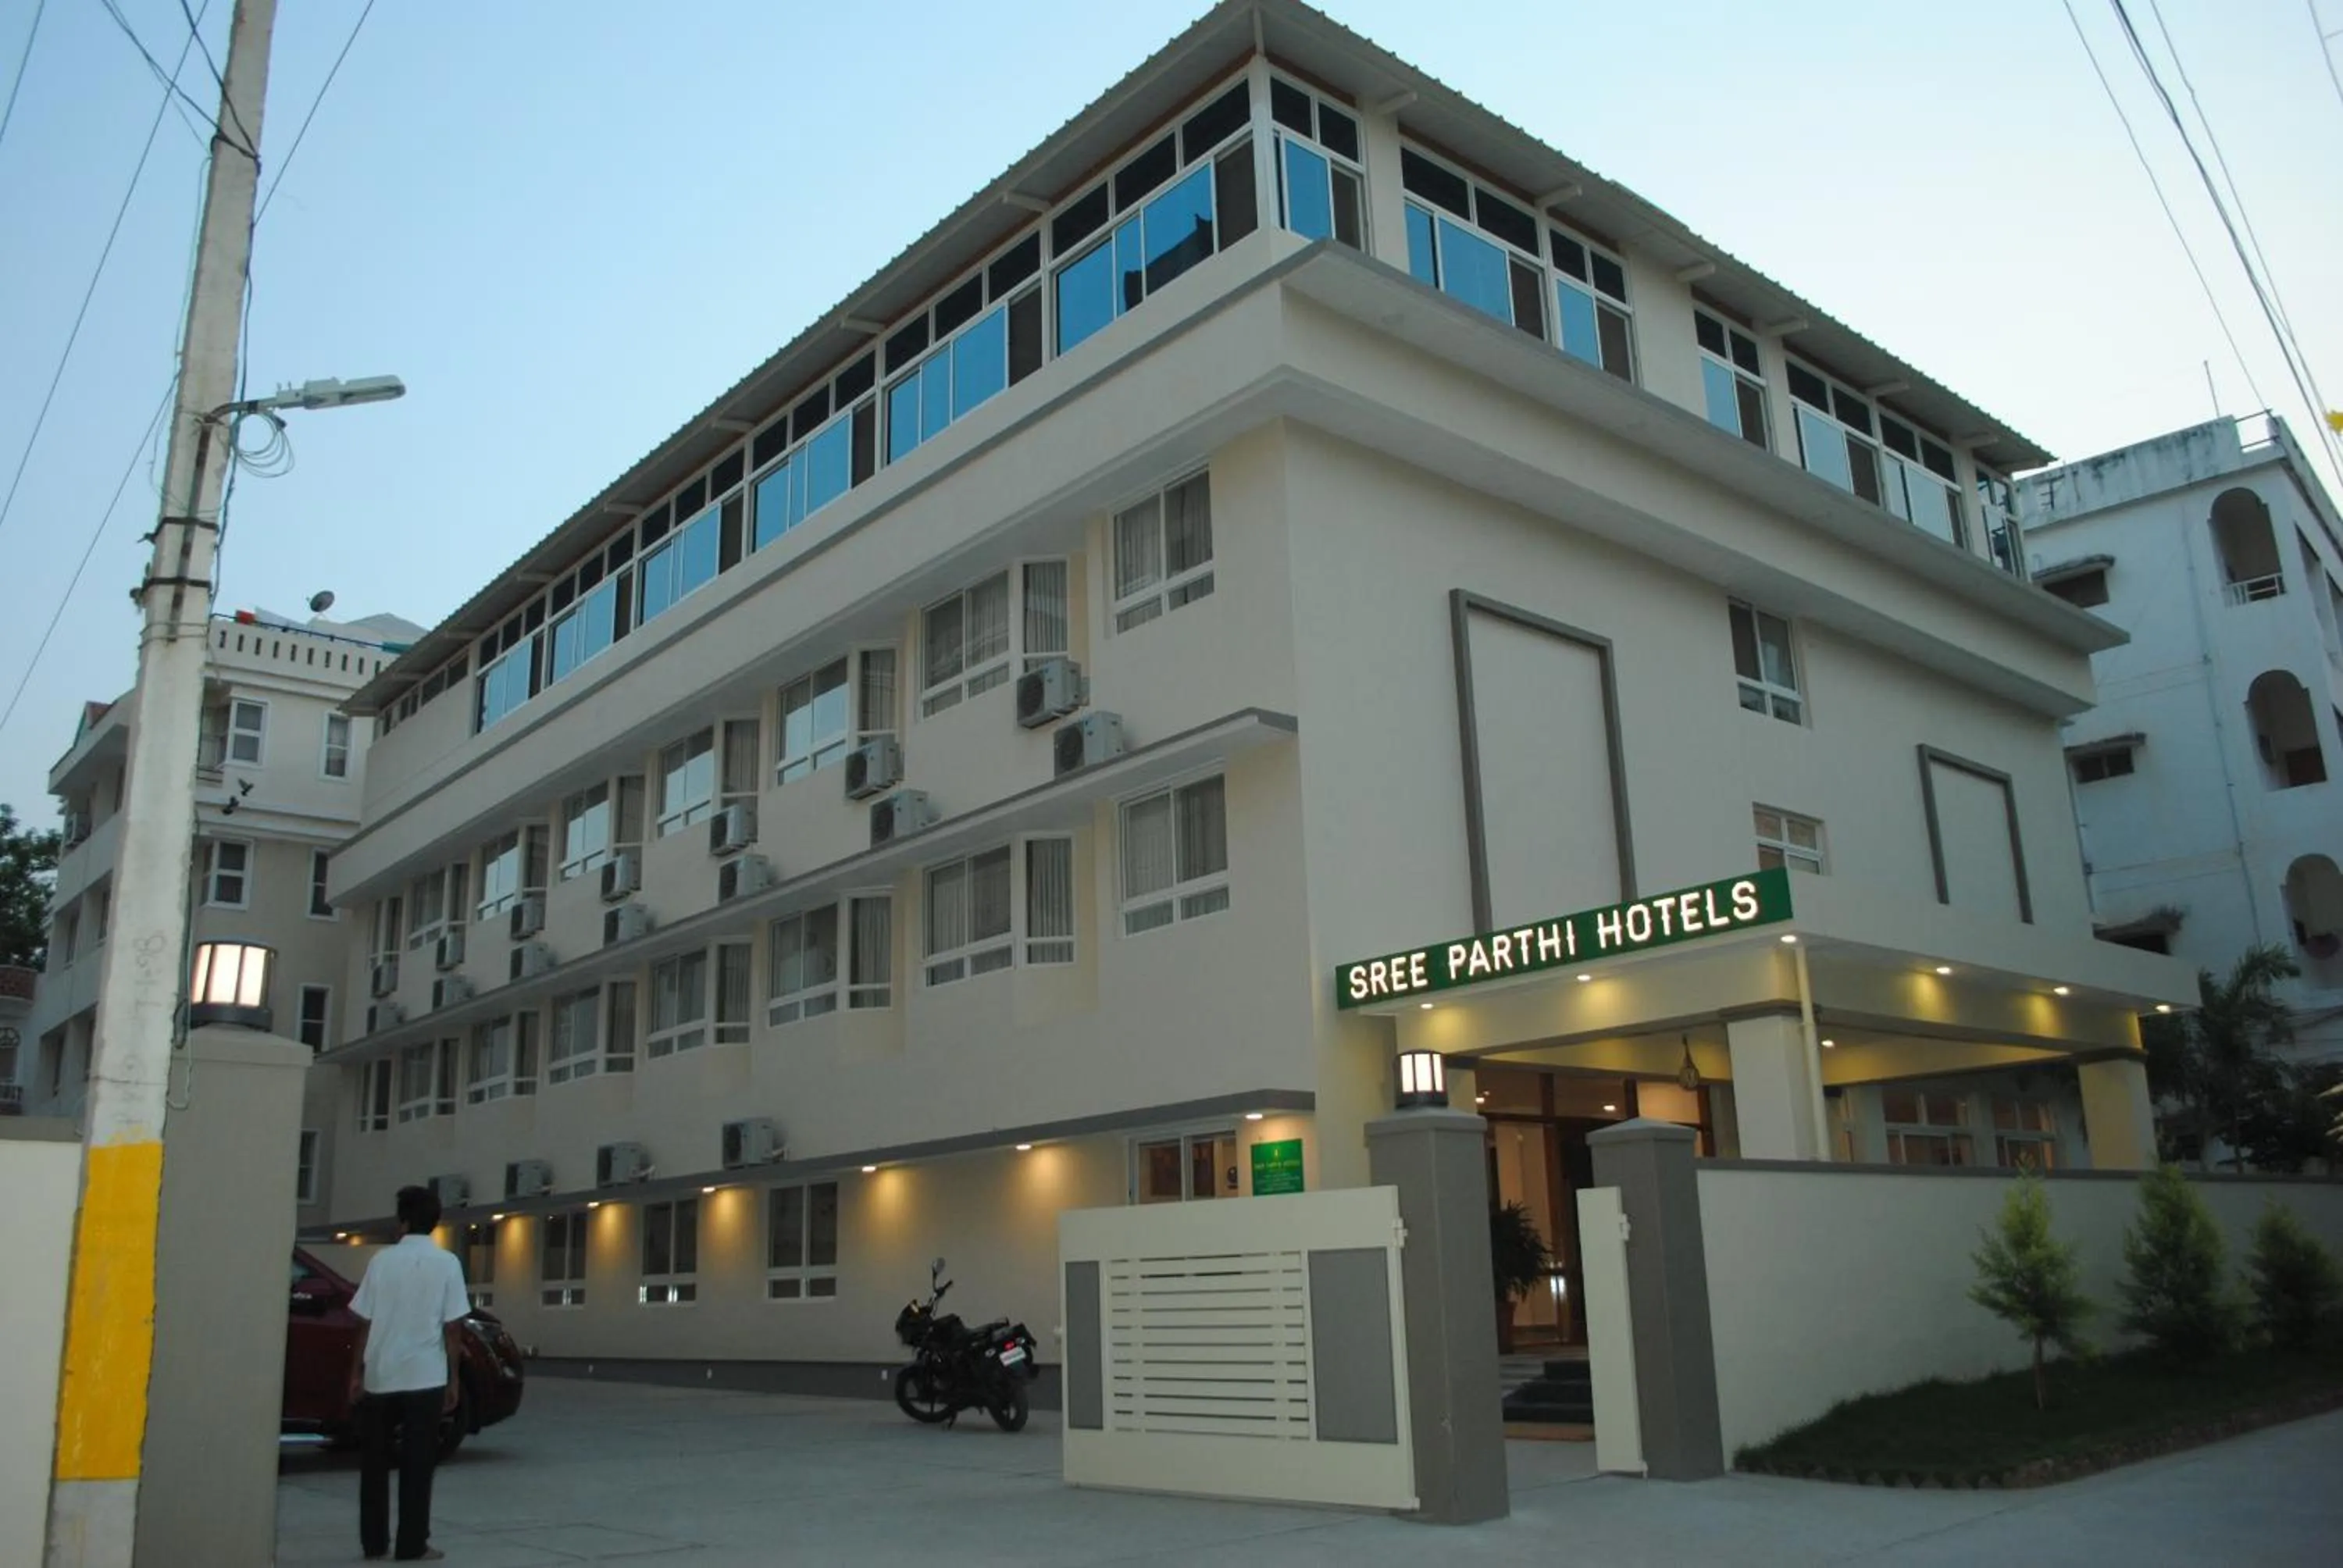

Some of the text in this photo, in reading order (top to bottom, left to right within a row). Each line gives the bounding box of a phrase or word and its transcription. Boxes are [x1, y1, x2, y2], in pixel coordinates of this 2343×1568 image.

[1349, 880, 1758, 1000] SREE PARTHI HOTELS
